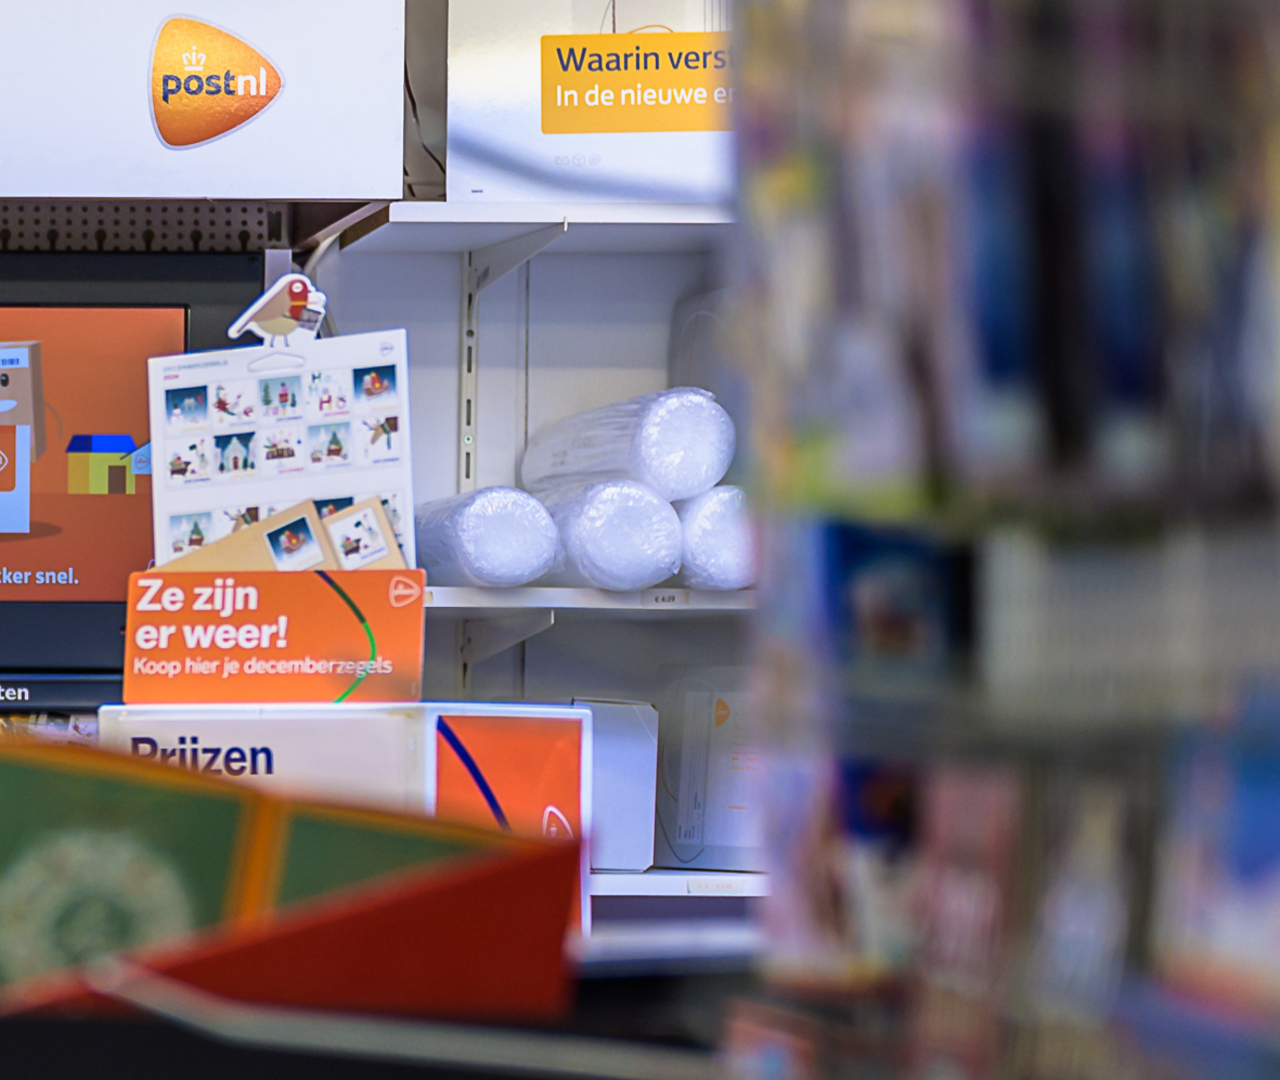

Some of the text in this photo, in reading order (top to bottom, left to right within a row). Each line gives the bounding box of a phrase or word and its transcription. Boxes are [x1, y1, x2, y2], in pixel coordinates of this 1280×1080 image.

[556, 46, 660, 72] Waarin
[161, 65, 267, 104] postnl
[556, 85, 578, 106] In
[585, 84, 614, 106] de
[621, 83, 708, 105] nieuwe
[35, 567, 79, 585] snel.
[136, 578, 258, 618] Ze zijn
[135, 615, 288, 649] er weer!
[133, 656, 393, 679] Koop hier je decemberzegels
